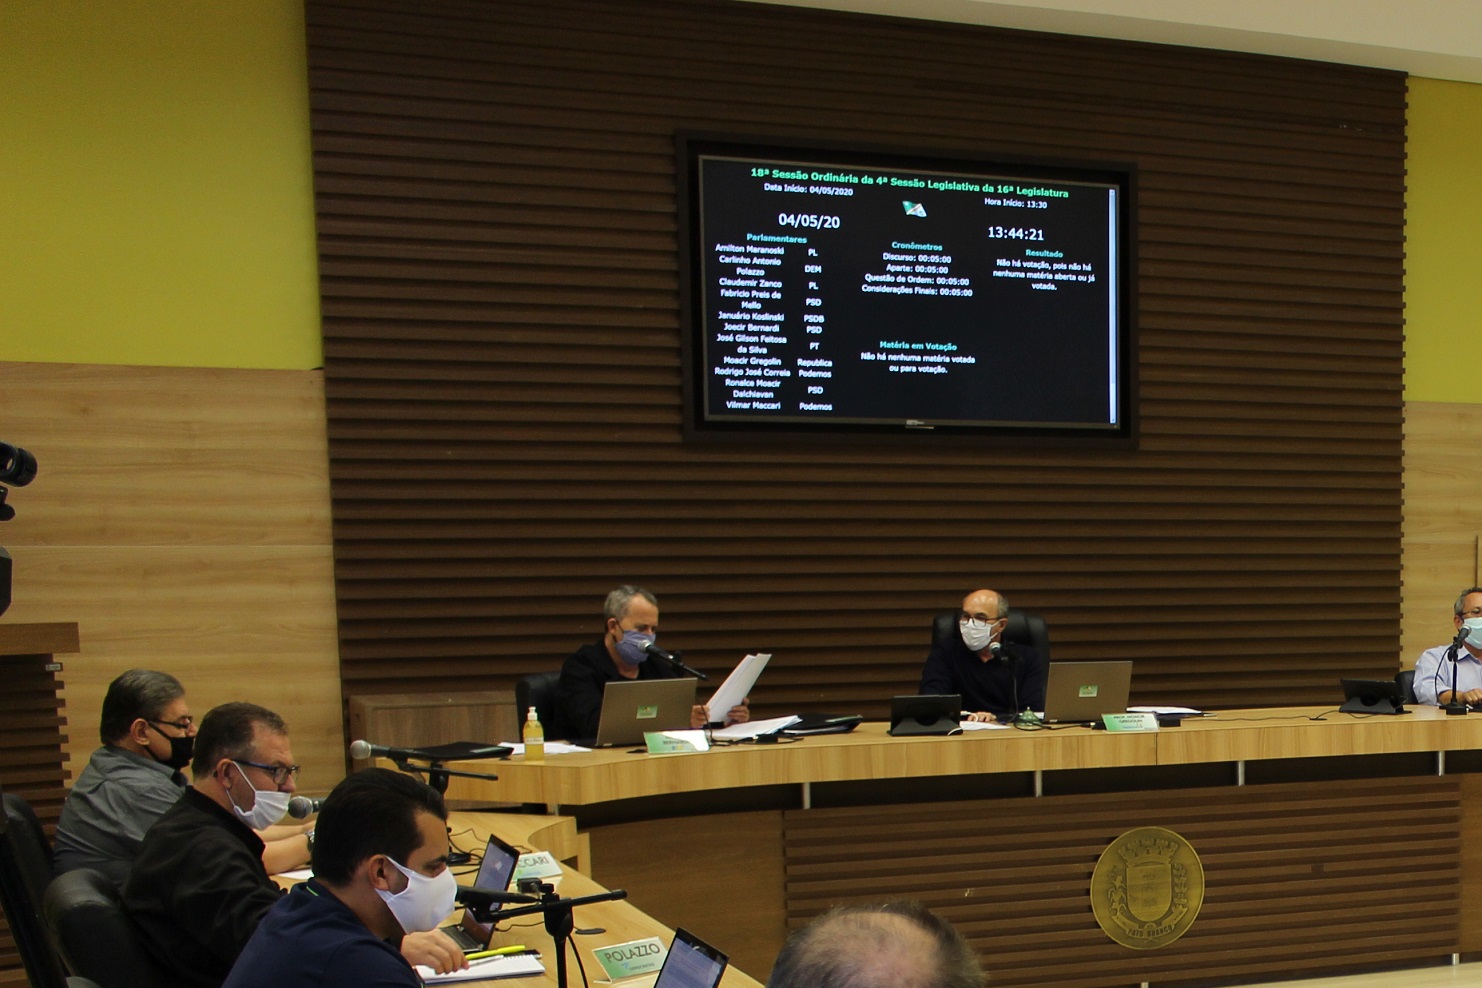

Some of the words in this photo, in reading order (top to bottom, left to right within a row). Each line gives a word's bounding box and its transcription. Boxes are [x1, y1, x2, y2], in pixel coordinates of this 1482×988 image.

[751, 168, 769, 177] 18ª
[772, 170, 808, 180] Sessão
[811, 172, 858, 183] Ordinária
[861, 175, 873, 184] da
[876, 176, 887, 185] 4ª
[890, 177, 925, 188] Sessão
[928, 180, 979, 192] Legislativa
[997, 185, 1014, 193] 16ª
[1017, 187, 1069, 198] Legislatura
[764, 183, 782, 192] Data
[784, 183, 807, 193] Início:
[810, 186, 853, 196] 04/05/2020
[985, 198, 1001, 206] Hora
[1003, 198, 1024, 207] Início:
[1027, 201, 1047, 209] 13:30
[779, 213, 840, 229] 04/05/20
[747, 233, 807, 243] Parlamentares
[988, 226, 1044, 240] 13:44:21
[892, 242, 942, 251] Cronômetros
[808, 249, 818, 257] PL
[883, 252, 916, 262] Discurso:
[918, 255, 951, 264] 00:05:00
[1026, 249, 1063, 258] Resultado
[719, 255, 750, 264] Carlinho
[752, 256, 781, 266] Antonio
[997, 258, 1010, 267] Não
[1012, 259, 1021, 268] há
[1023, 260, 1051, 270] votação,
[1053, 262, 1067, 272] pois
[1069, 262, 1081, 271] não
[1083, 262, 1091, 271] há
[736, 267, 764, 276] Polazzo
[805, 265, 822, 273] DEM
[886, 263, 913, 273] Aparte:
[915, 266, 948, 274] 00:05:00
[865, 273, 895, 283] Questão
[896, 275, 906, 283] de
[907, 276, 934, 284] Ordem:
[936, 277, 969, 286] 00:05:00
[993, 270, 1025, 279] nenhuma
[1027, 270, 1052, 280] matéria
[1055, 272, 1076, 281] aberta
[1088, 273, 1095, 283] já
[719, 278, 757, 287] Claudemir
[759, 279, 782, 288] Zanco
[809, 282, 818, 290] PL
[1032, 282, 1057, 291] votada.
[751, 290, 769, 299] Preis
[771, 291, 781, 299] de
[862, 284, 913, 295] Considerações
[915, 286, 937, 295] Finais:
[940, 288, 972, 297] 00:05:00
[806, 298, 822, 306] PSD
[718, 311, 750, 320] Januário
[752, 312, 784, 321] Koslinski
[804, 314, 824, 323] PSDB
[748, 324, 779, 332] Bernardi
[807, 326, 822, 334] PSD
[717, 334, 733, 342] José
[735, 334, 758, 343] Gilson
[760, 335, 787, 344] Feitosa
[749, 346, 767, 354] Silva
[810, 342, 819, 350] PT
[880, 341, 909, 349] Matéria
[926, 342, 957, 352] Votação
[724, 356, 748, 365] Moacir
[750, 357, 781, 367] Gregolin
[861, 352, 875, 360] Não
[877, 352, 886, 360] há
[888, 353, 921, 362] nenhuma
[923, 354, 950, 363] matéria
[951, 355, 976, 364] votada
[715, 367, 743, 377] Rodrigo
[745, 368, 762, 376] José
[799, 370, 831, 378] Podemos
[900, 365, 916, 374] para
[918, 365, 948, 374] votação.
[756, 380, 781, 388] Moacir
[808, 386, 823, 394] PSD
[726, 401, 751, 409] Vilmar
[753, 402, 780, 410] Maccari
[799, 403, 832, 411] Podemos
[517, 856, 550, 868] CCARI
[604, 944, 660, 963] POLAZZO
